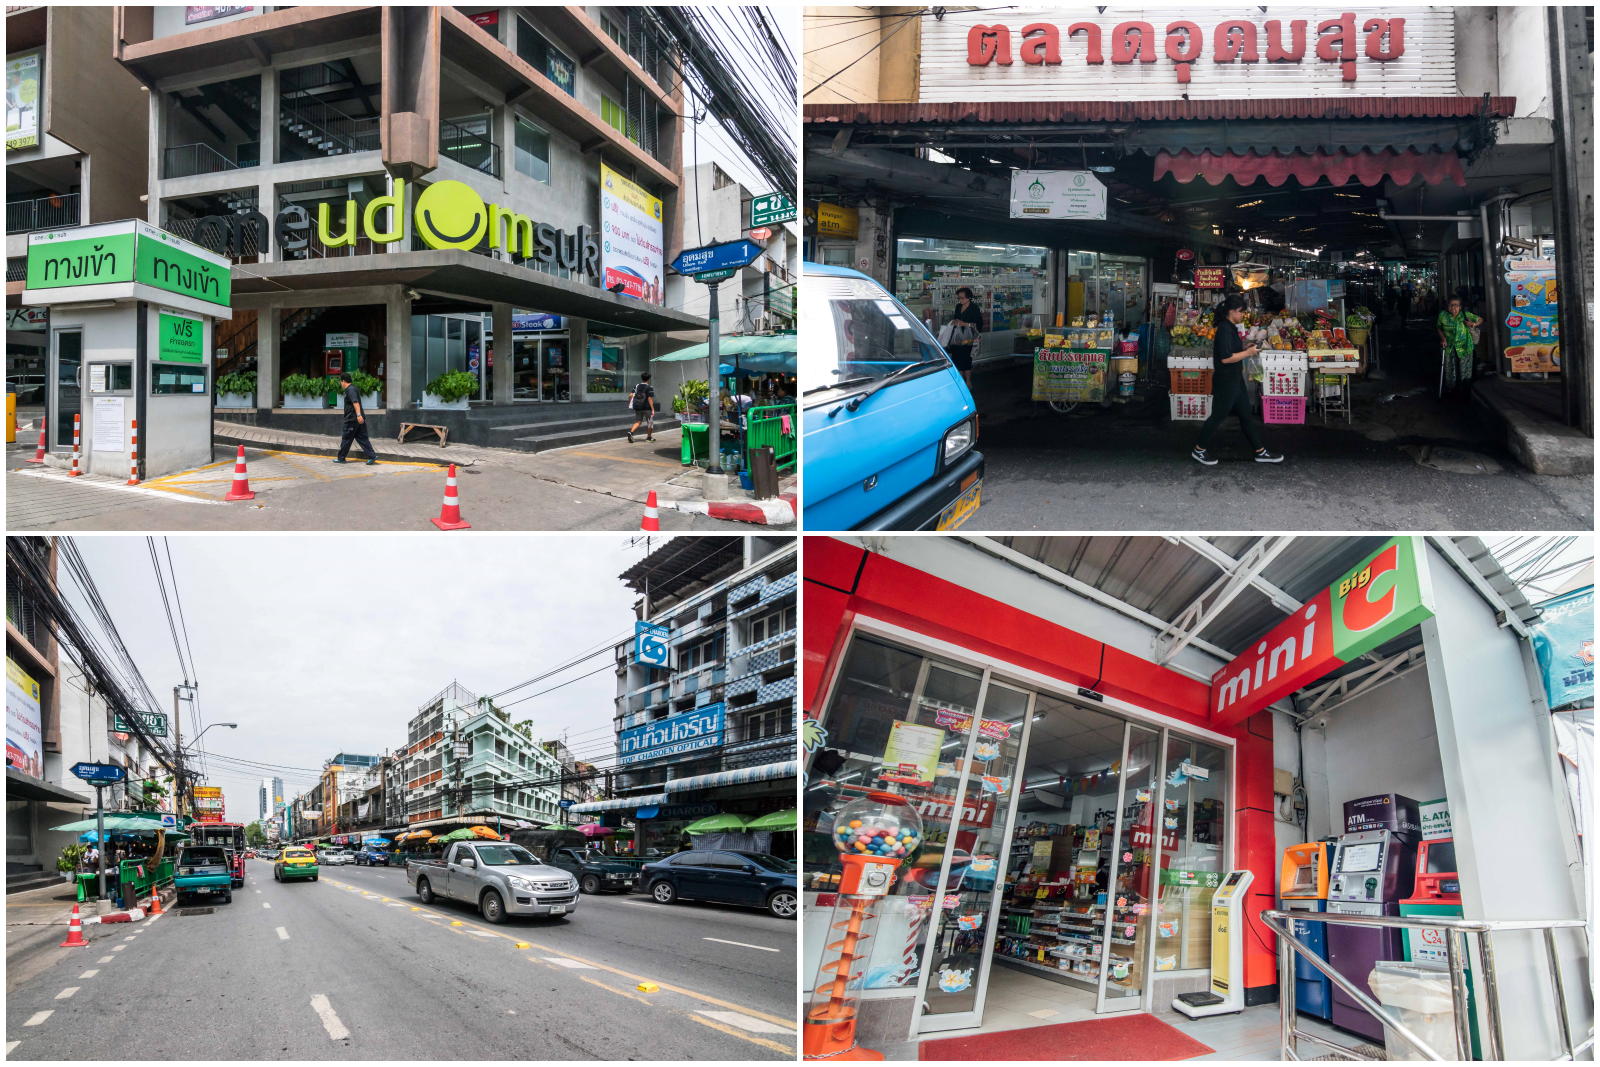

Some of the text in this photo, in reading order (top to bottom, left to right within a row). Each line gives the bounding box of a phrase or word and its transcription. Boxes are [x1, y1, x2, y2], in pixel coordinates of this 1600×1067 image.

[966, 12, 1406, 82] ตลาดอุดมสุข
[18, 136, 35, 147] 3977
[821, 220, 840, 228] atm
[44, 244, 116, 281] ทางเข้า
[682, 250, 714, 264] อุดมสุข
[741, 244, 748, 257] 1
[153, 257, 219, 298] ทางเข้า
[173, 319, 193, 338] ฟรี
[521, 320, 543, 328] Steak
[1339, 565, 1373, 600] Big
[650, 629, 669, 639] CHAROEN
[1216, 603, 1318, 713] mini
[622, 713, 718, 754] แว่นท็อปเจริญ
[622, 737, 716, 765] TOP CHAROEN OPTICAL
[115, 768, 119, 776] 1
[661, 805, 717, 817] CHAROEN
[1347, 813, 1365, 826] ATM
[1432, 936, 1442, 944] 24
